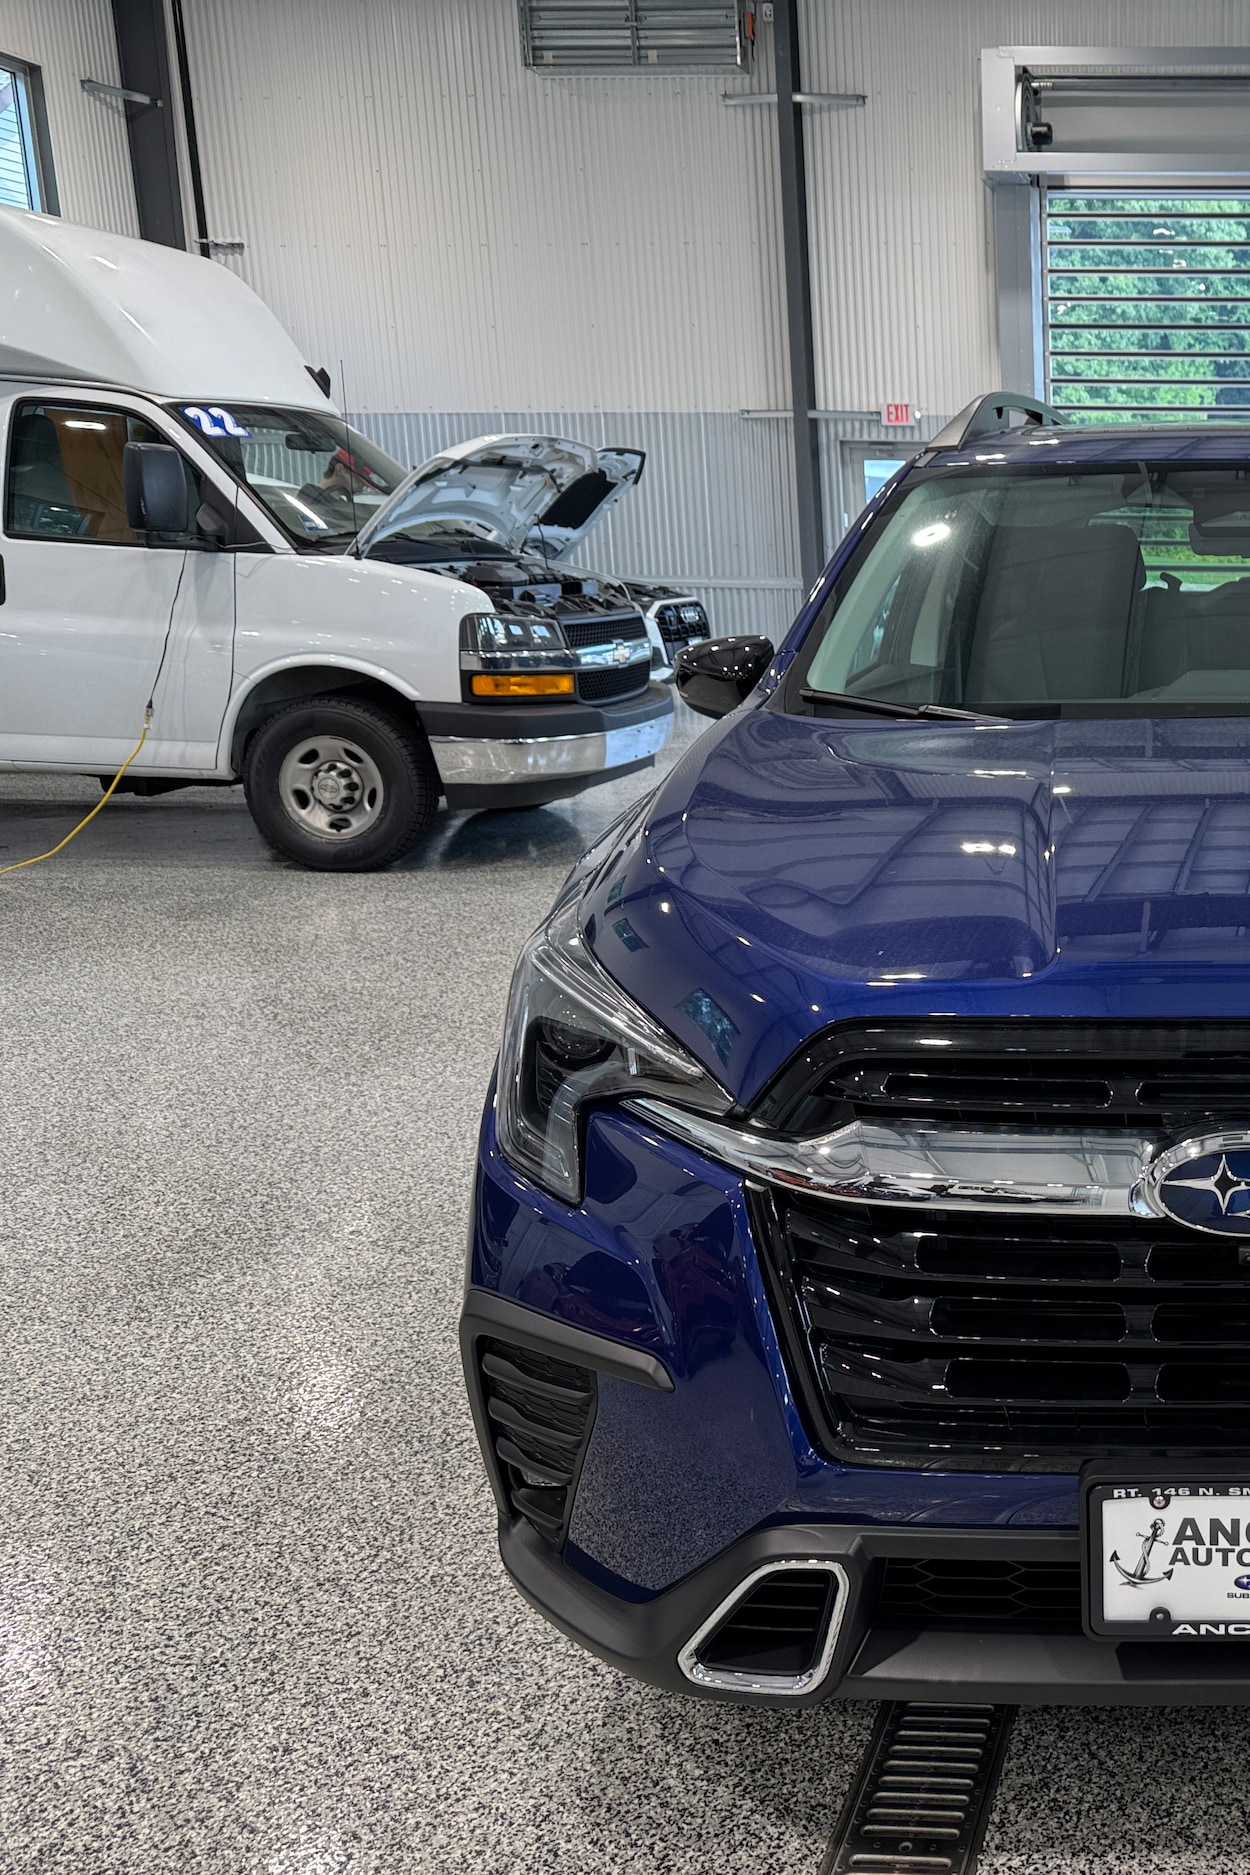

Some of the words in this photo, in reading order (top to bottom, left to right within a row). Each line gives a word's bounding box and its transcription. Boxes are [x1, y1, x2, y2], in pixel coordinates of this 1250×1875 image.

[184, 406, 249, 436] 22
[886, 403, 910, 423] EXIT
[1113, 1488, 1142, 1498] RT.
[1152, 1487, 1190, 1496] 146
[1199, 1487, 1220, 1496] N.
